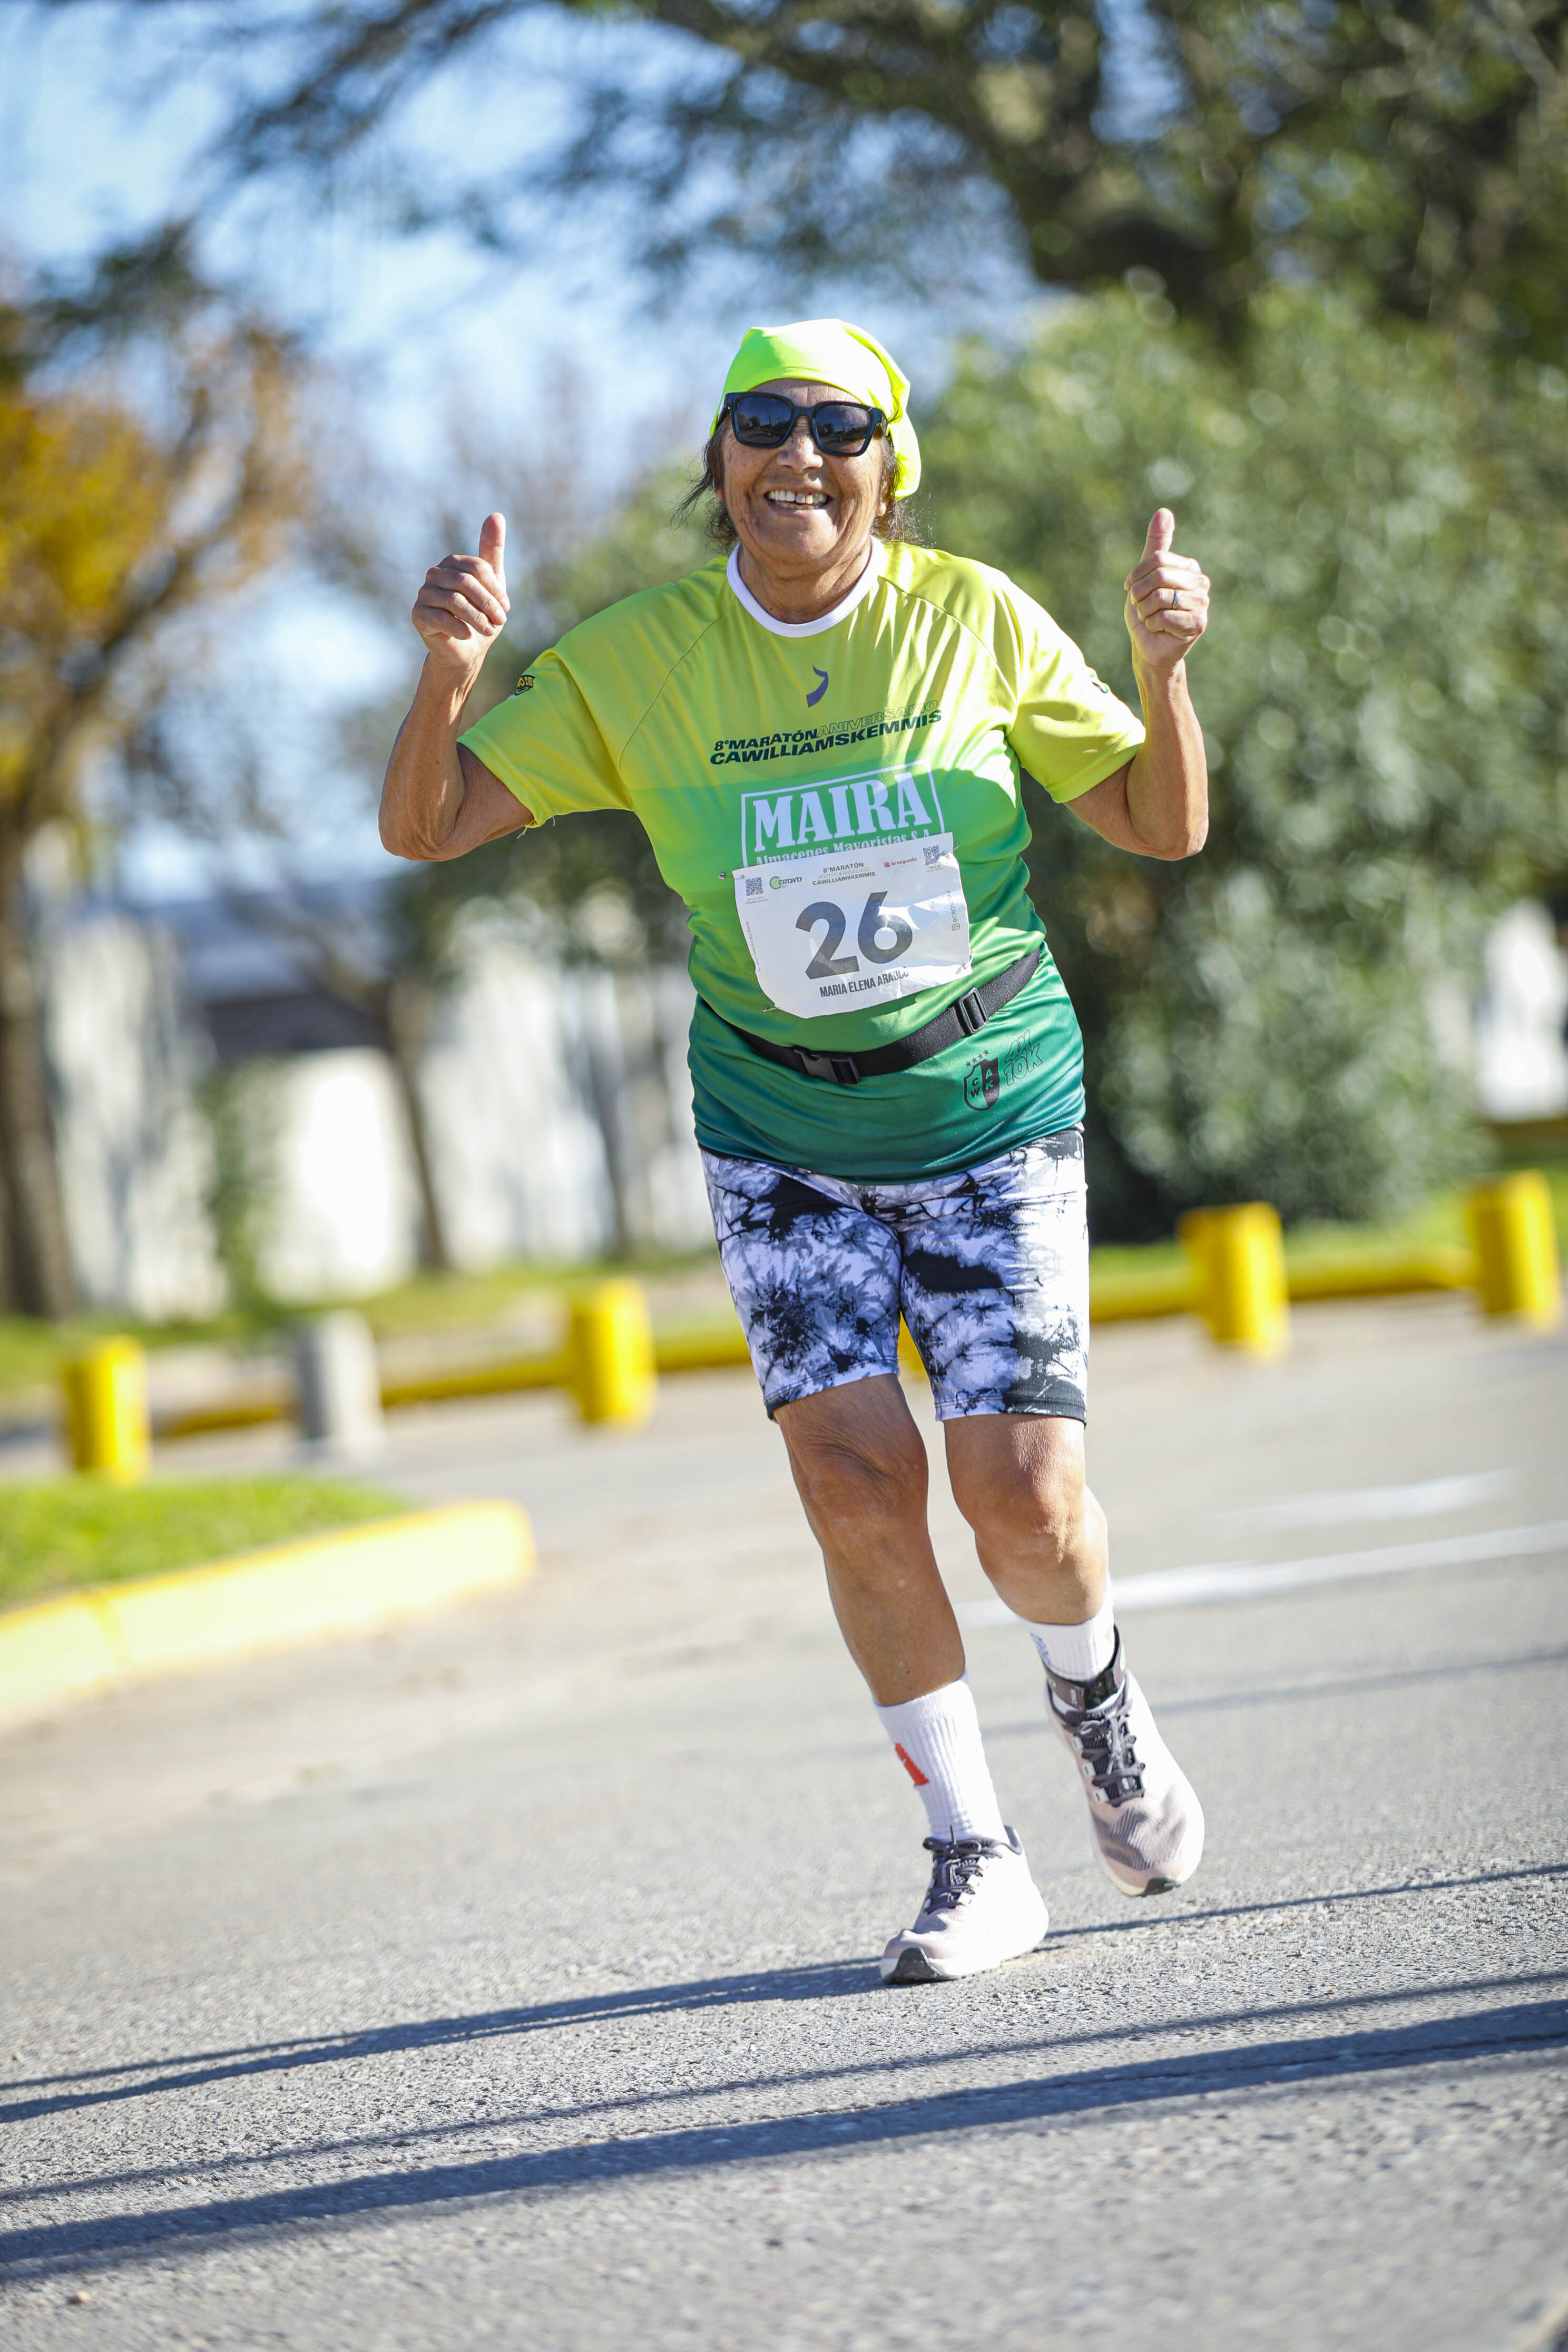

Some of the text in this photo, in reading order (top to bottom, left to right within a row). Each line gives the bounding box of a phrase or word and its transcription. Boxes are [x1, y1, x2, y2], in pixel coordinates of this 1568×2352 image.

[710, 709, 942, 765] CAWILLIAMSKEMMIS
[752, 771, 932, 852] MAIRA
[812, 871, 876, 886] CAWILLIAMSKEMMIS
[796, 890, 913, 979] 26
[819, 983, 847, 997] MARIA
[848, 977, 876, 993] ELENA
[1004, 1043, 1043, 1086] 10K
